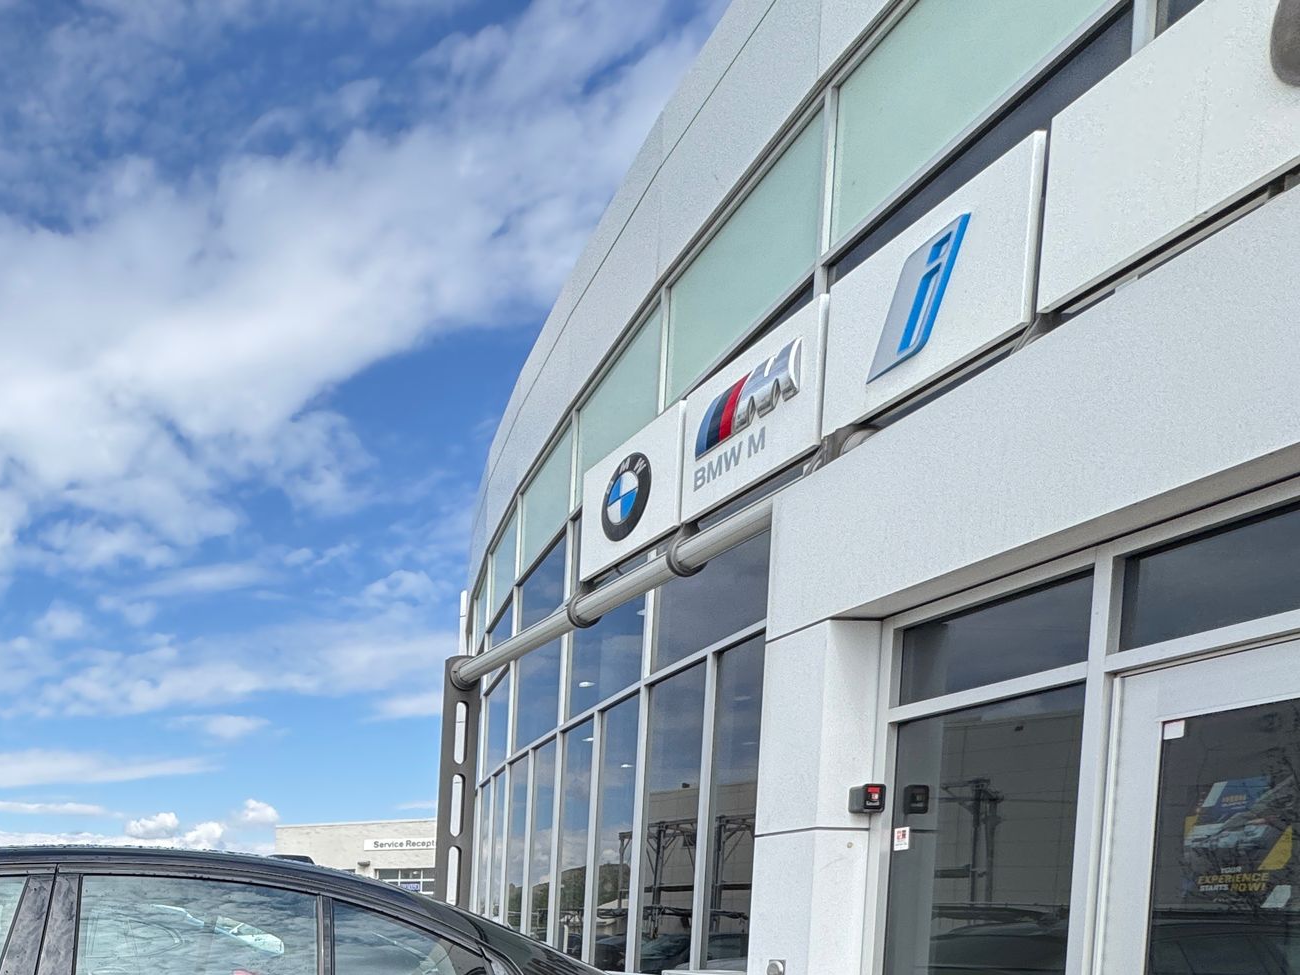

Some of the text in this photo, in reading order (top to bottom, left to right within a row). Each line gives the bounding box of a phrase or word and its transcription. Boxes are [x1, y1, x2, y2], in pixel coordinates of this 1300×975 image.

[693, 425, 766, 492] BMW M
[373, 840, 404, 849] Service
[1198, 873, 1269, 884] EXPERIENCE
